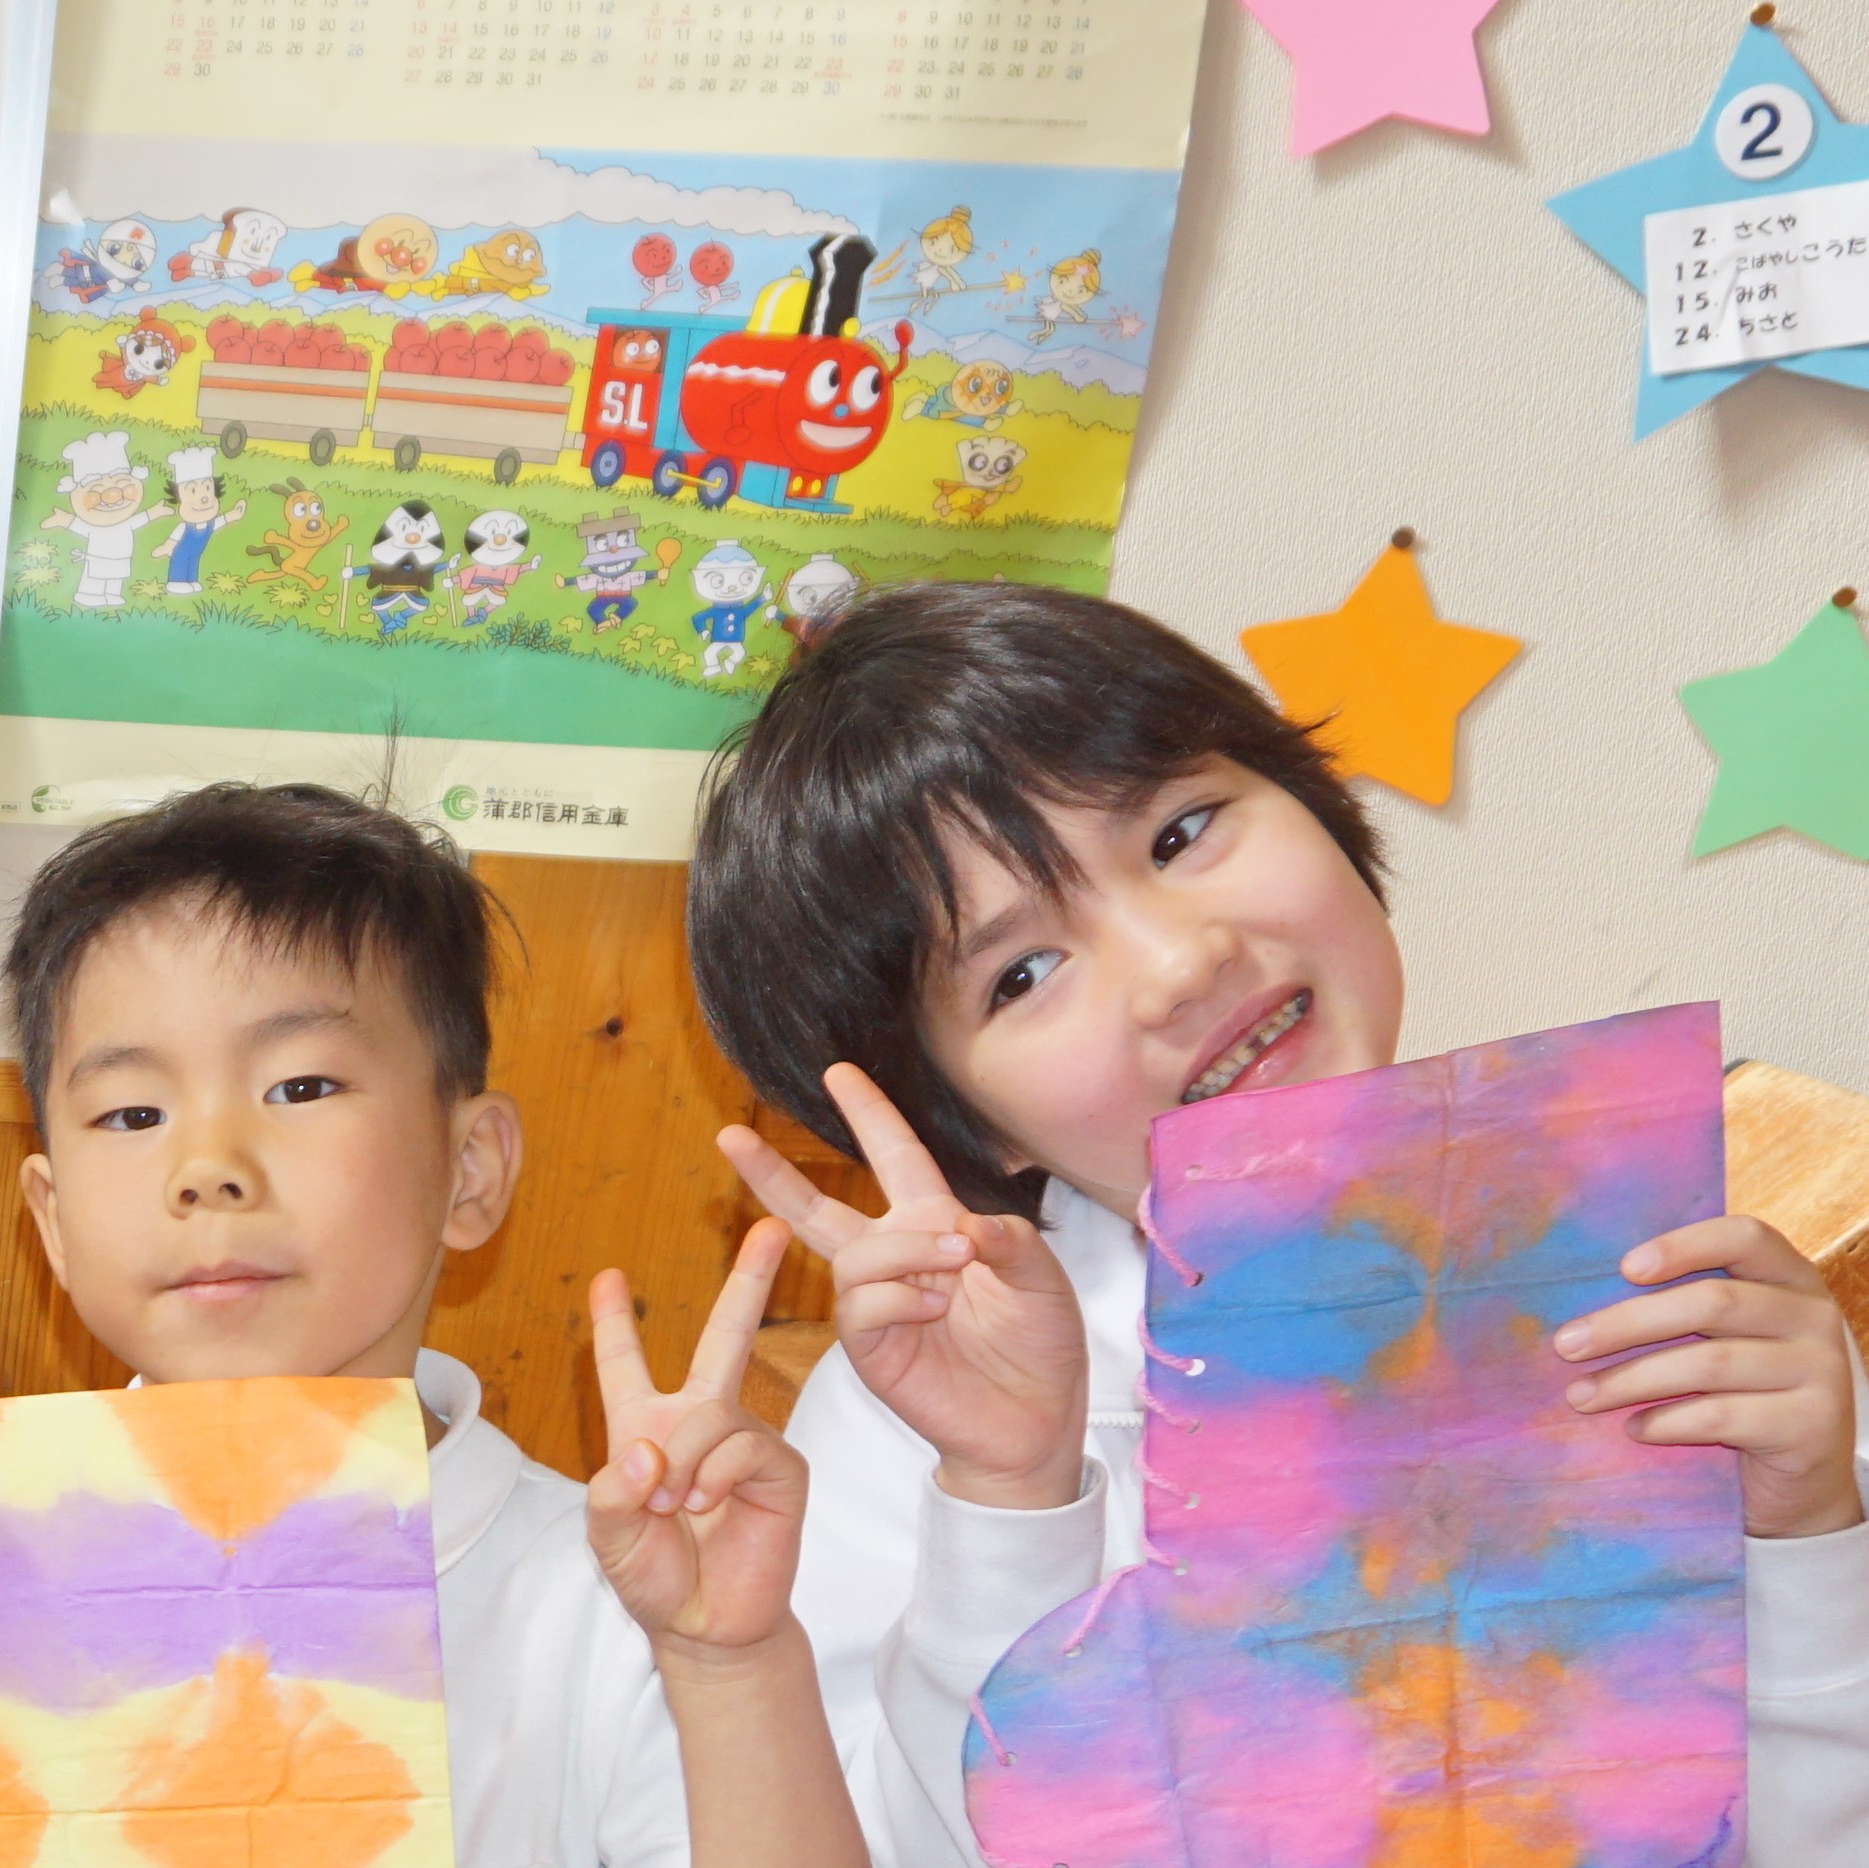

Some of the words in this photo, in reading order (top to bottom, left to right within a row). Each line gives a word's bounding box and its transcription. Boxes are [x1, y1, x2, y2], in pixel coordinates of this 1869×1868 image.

[1739, 101, 1784, 161] 2
[1735, 214, 1797, 241] さくや
[1735, 281, 1778, 304] みお
[1739, 312, 1798, 336] ちさと
[483, 798, 630, 828] 蒲郡信用金庫
